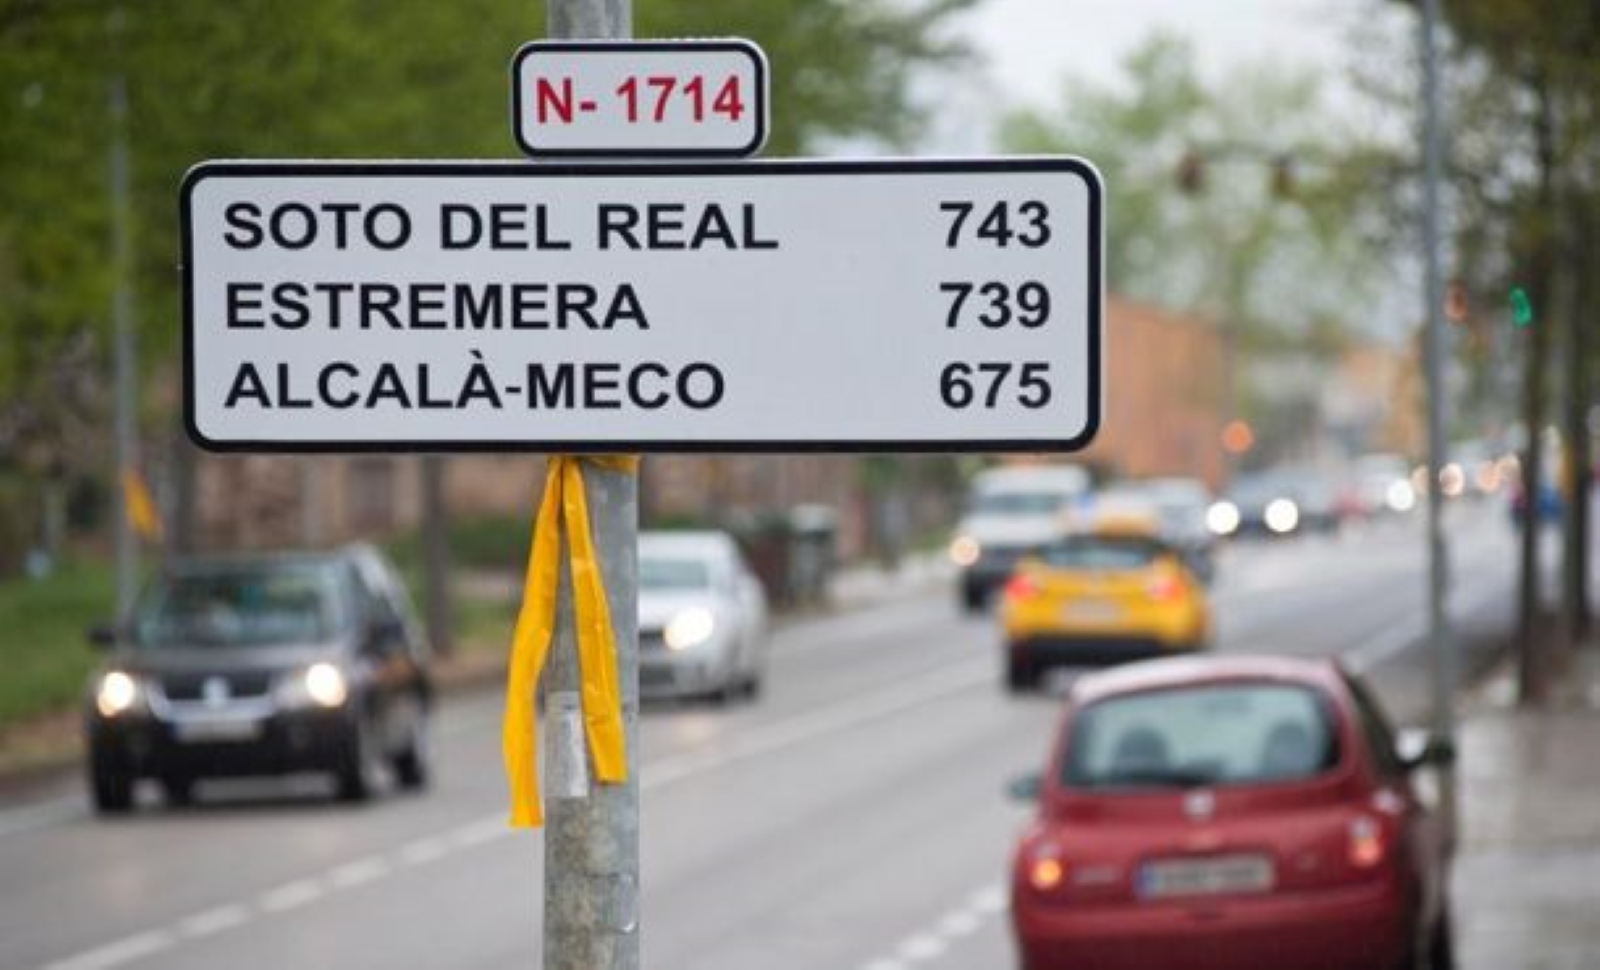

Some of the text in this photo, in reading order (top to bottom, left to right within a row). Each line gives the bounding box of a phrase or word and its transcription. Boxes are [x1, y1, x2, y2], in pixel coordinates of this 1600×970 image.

[616, 75, 744, 122] 1714
[223, 200, 1052, 251] SOTO DEL REAL 743
[226, 281, 1052, 331] ESTREMERA 739
[223, 349, 1052, 410] ALCALÀ-MECO 675
